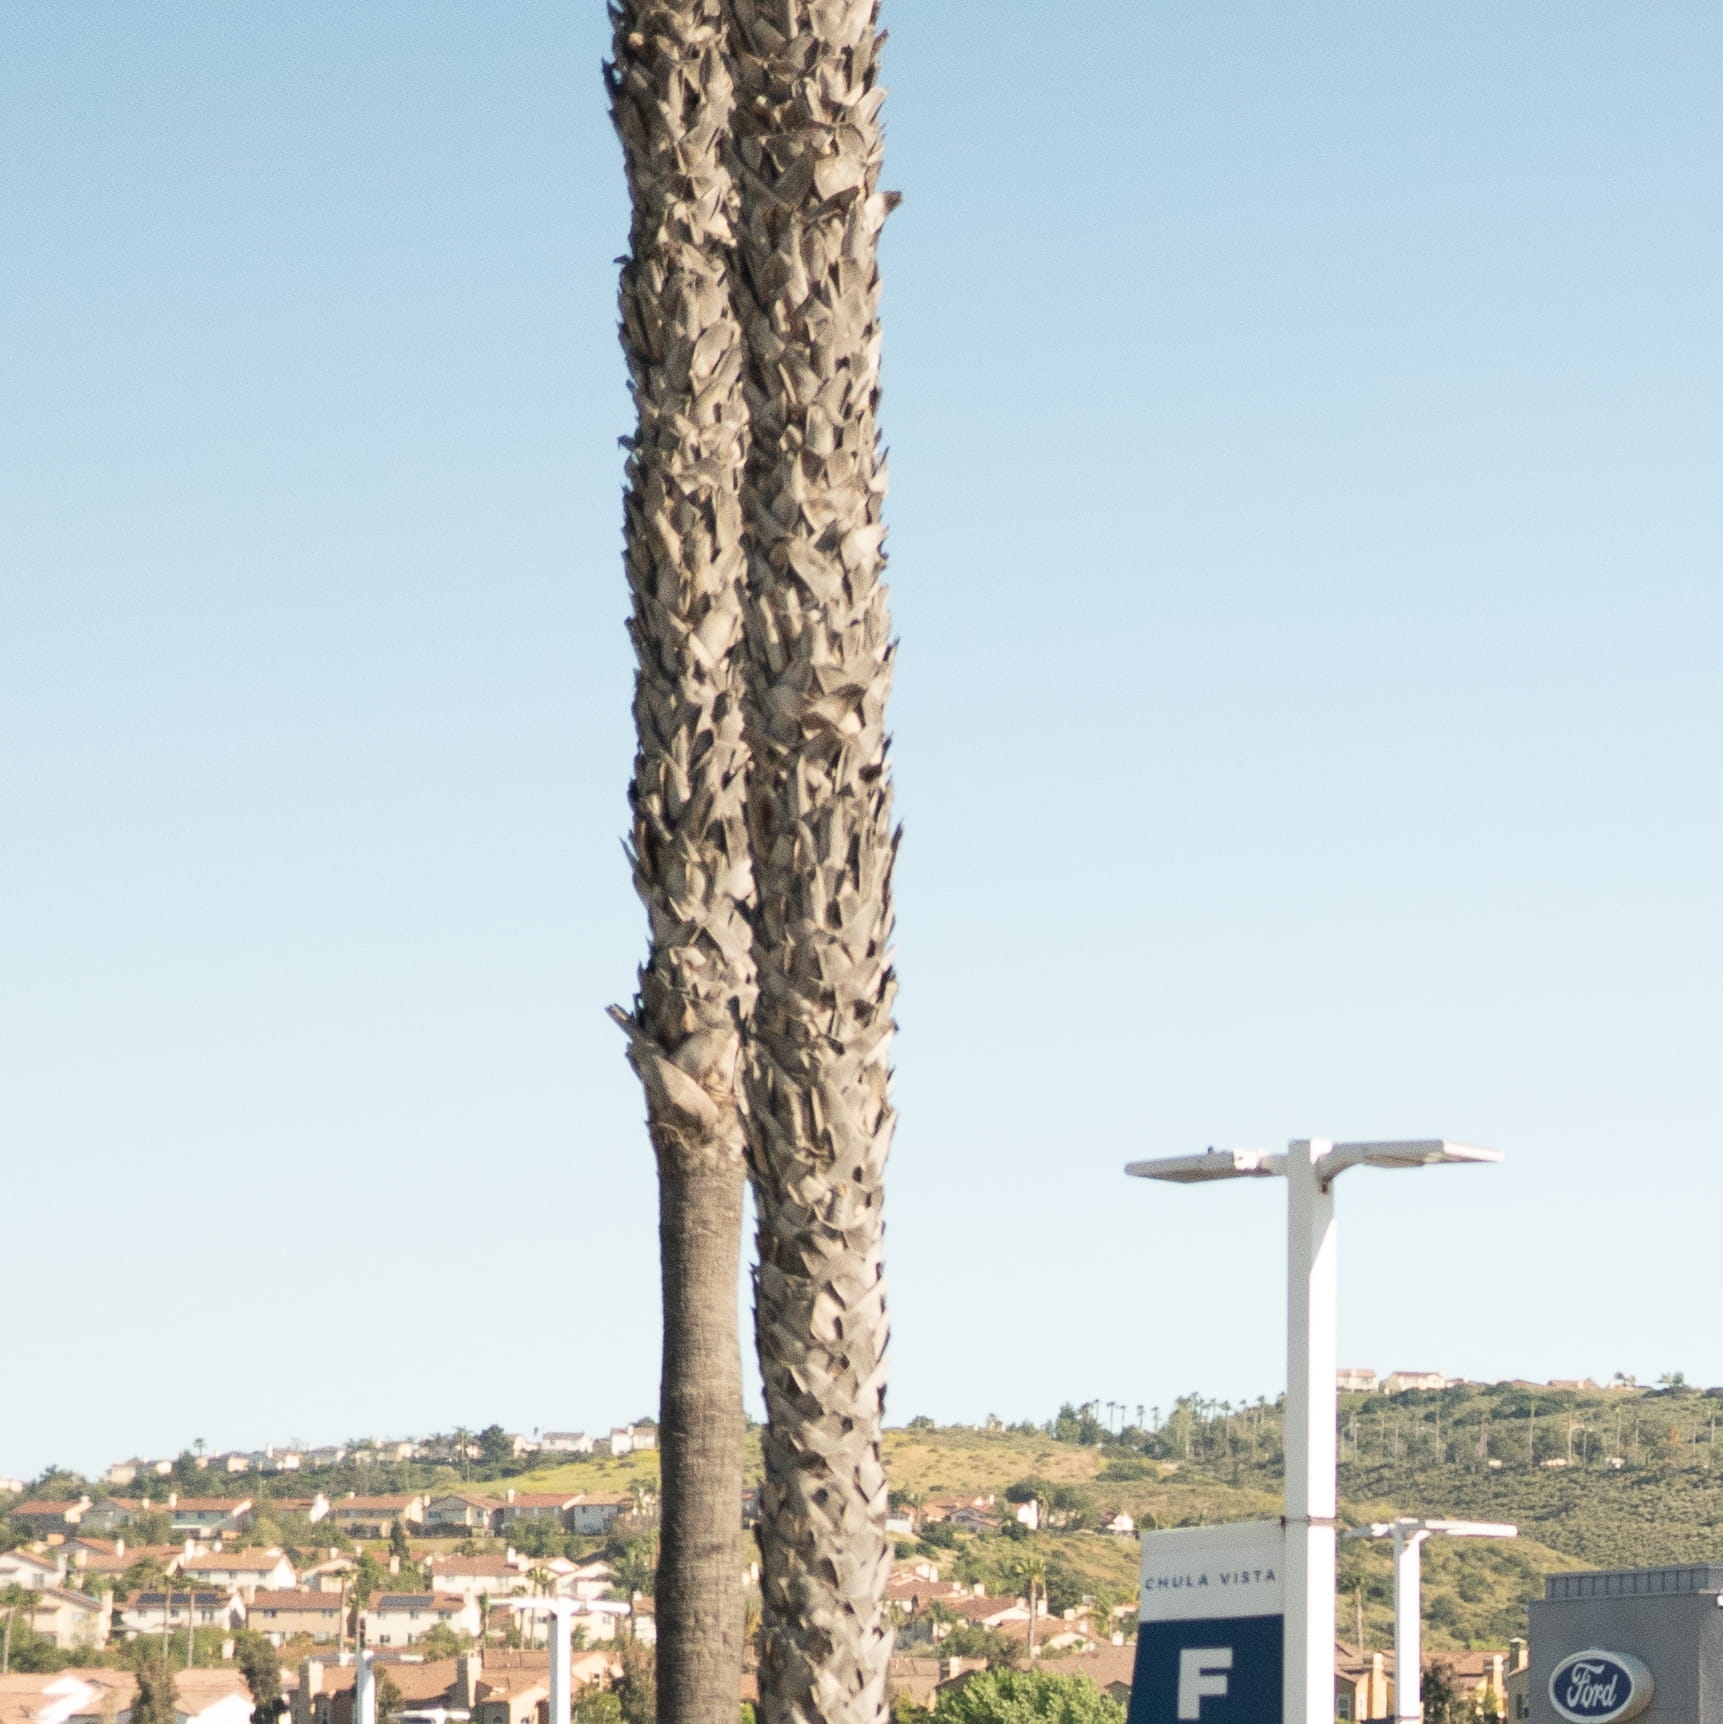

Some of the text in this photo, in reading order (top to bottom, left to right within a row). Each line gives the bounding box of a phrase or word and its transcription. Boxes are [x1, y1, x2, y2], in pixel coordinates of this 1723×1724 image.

[1145, 1568, 1276, 1590] CHULA VISTA
[1566, 1661, 1619, 1709] Ford
